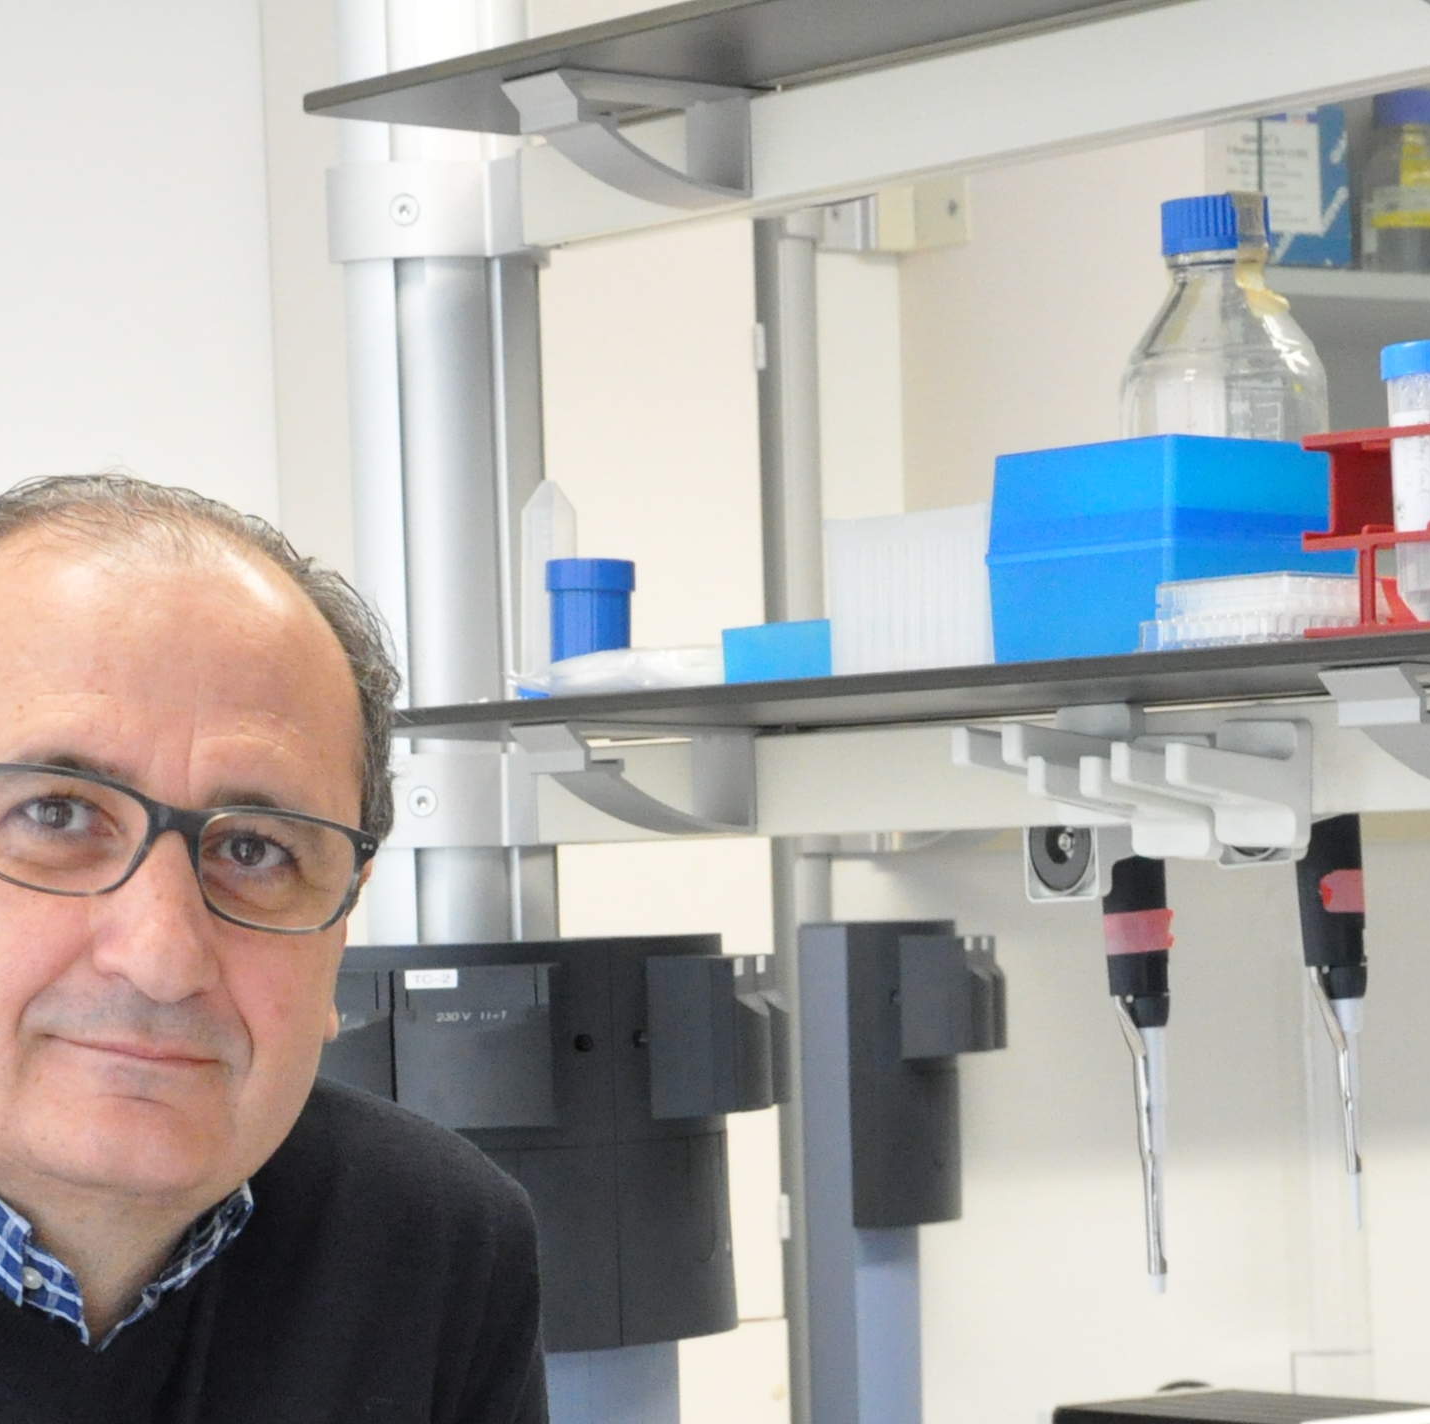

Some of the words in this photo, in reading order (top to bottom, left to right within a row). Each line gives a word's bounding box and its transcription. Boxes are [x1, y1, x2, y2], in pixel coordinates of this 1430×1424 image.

[413, 973, 450, 985] TC-2
[436, 1011, 460, 1023] 230
[461, 1011, 472, 1022] V
